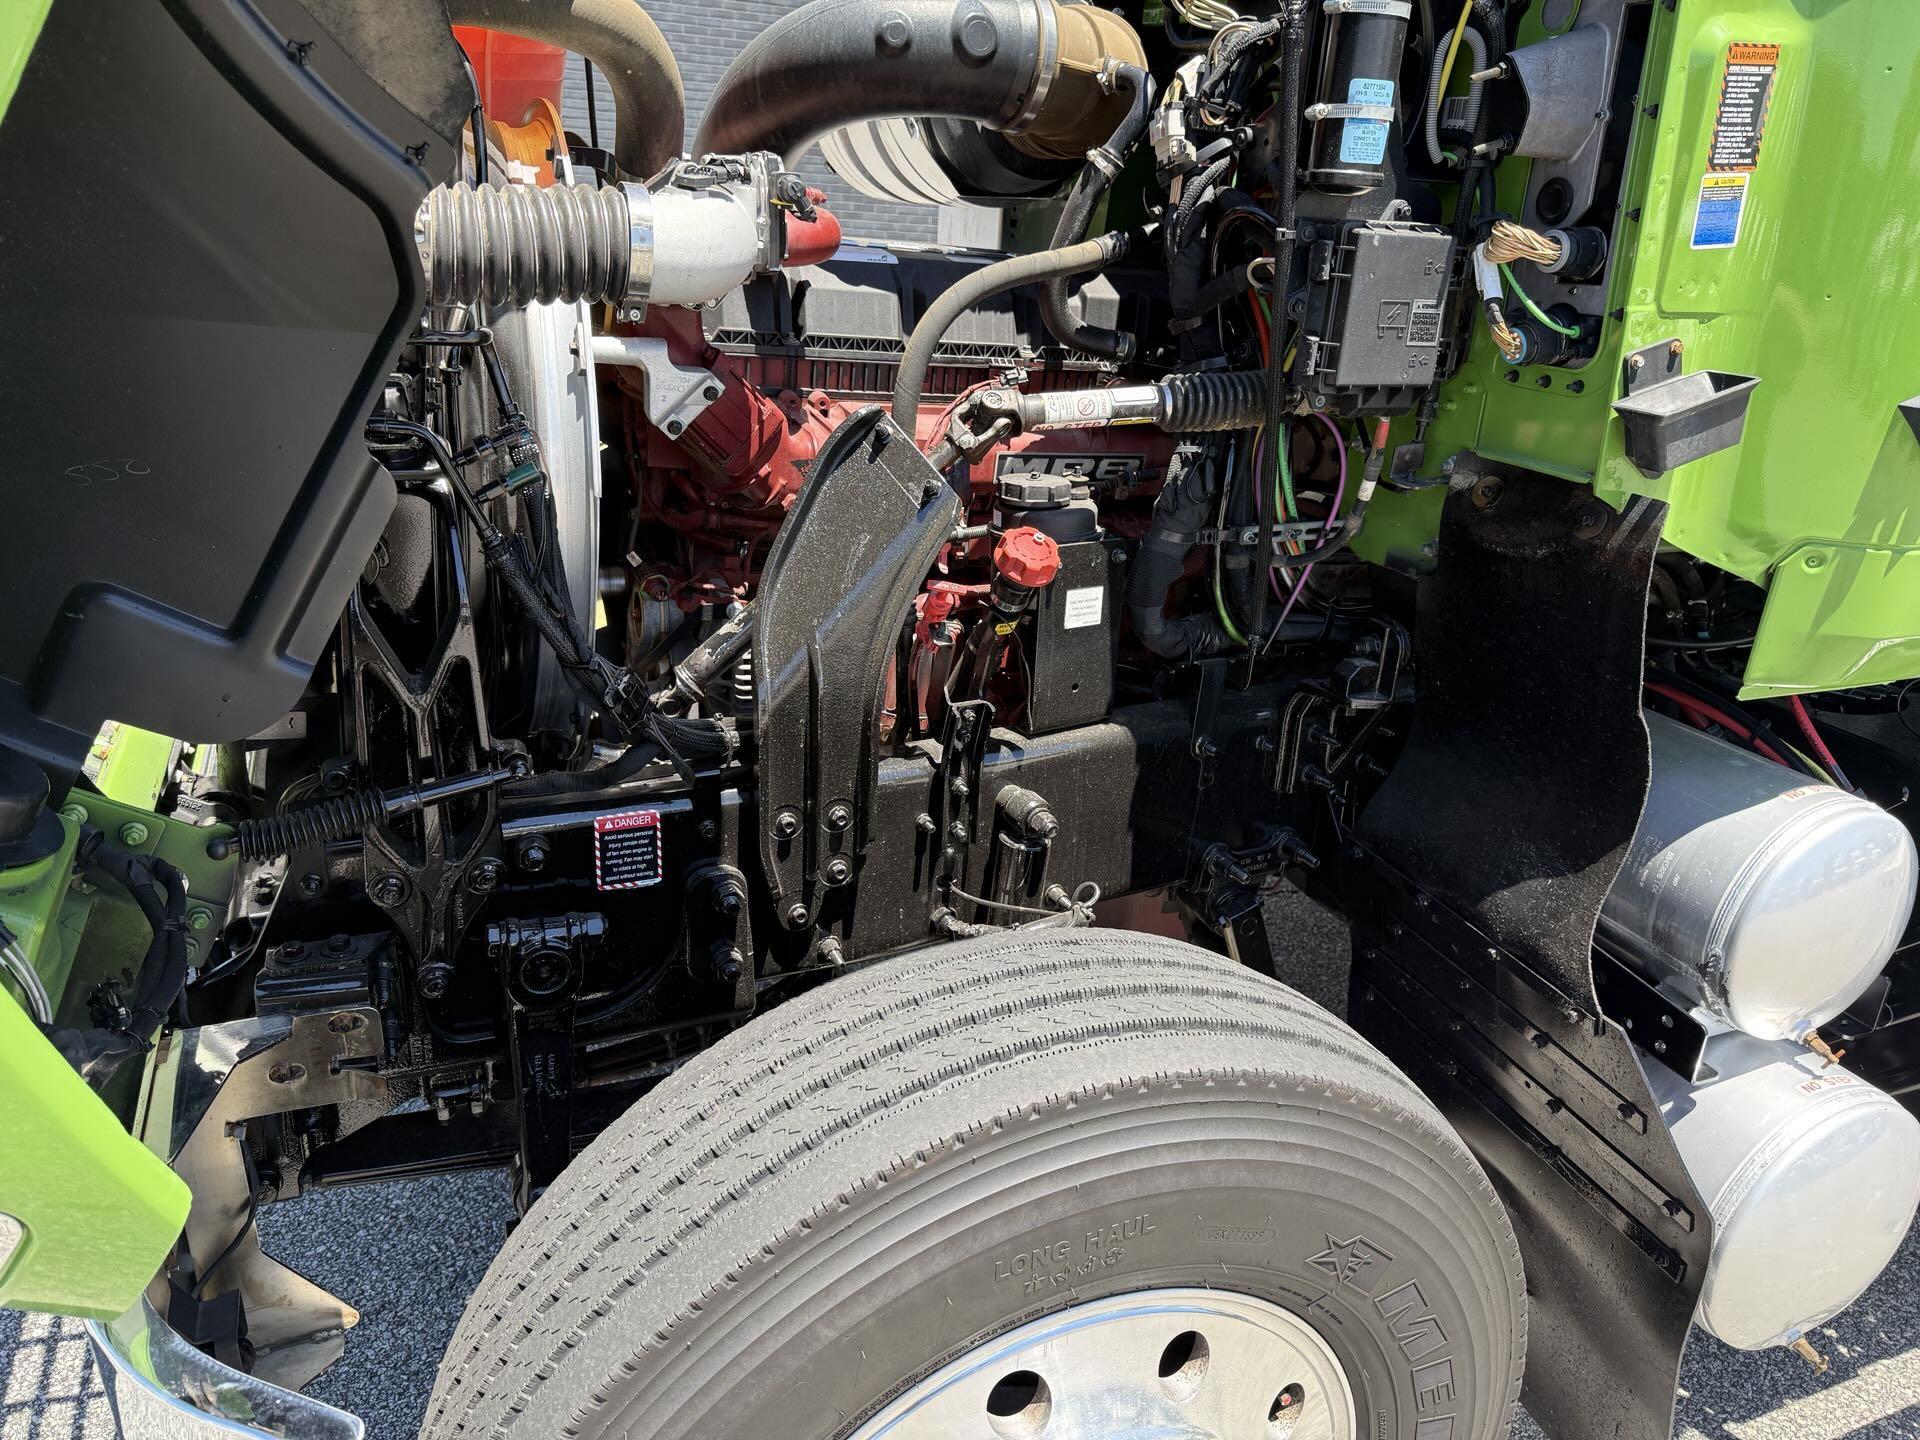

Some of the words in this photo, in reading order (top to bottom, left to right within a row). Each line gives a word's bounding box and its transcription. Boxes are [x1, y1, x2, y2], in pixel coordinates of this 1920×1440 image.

[1740, 52, 1775, 60] WARNING
[1784, 789, 1806, 799] NO
[615, 816, 651, 827] DANGER
[1801, 1080, 1822, 1093] NO
[994, 1240, 1072, 1283] LONG
[1084, 1214, 1156, 1253] HAUL
